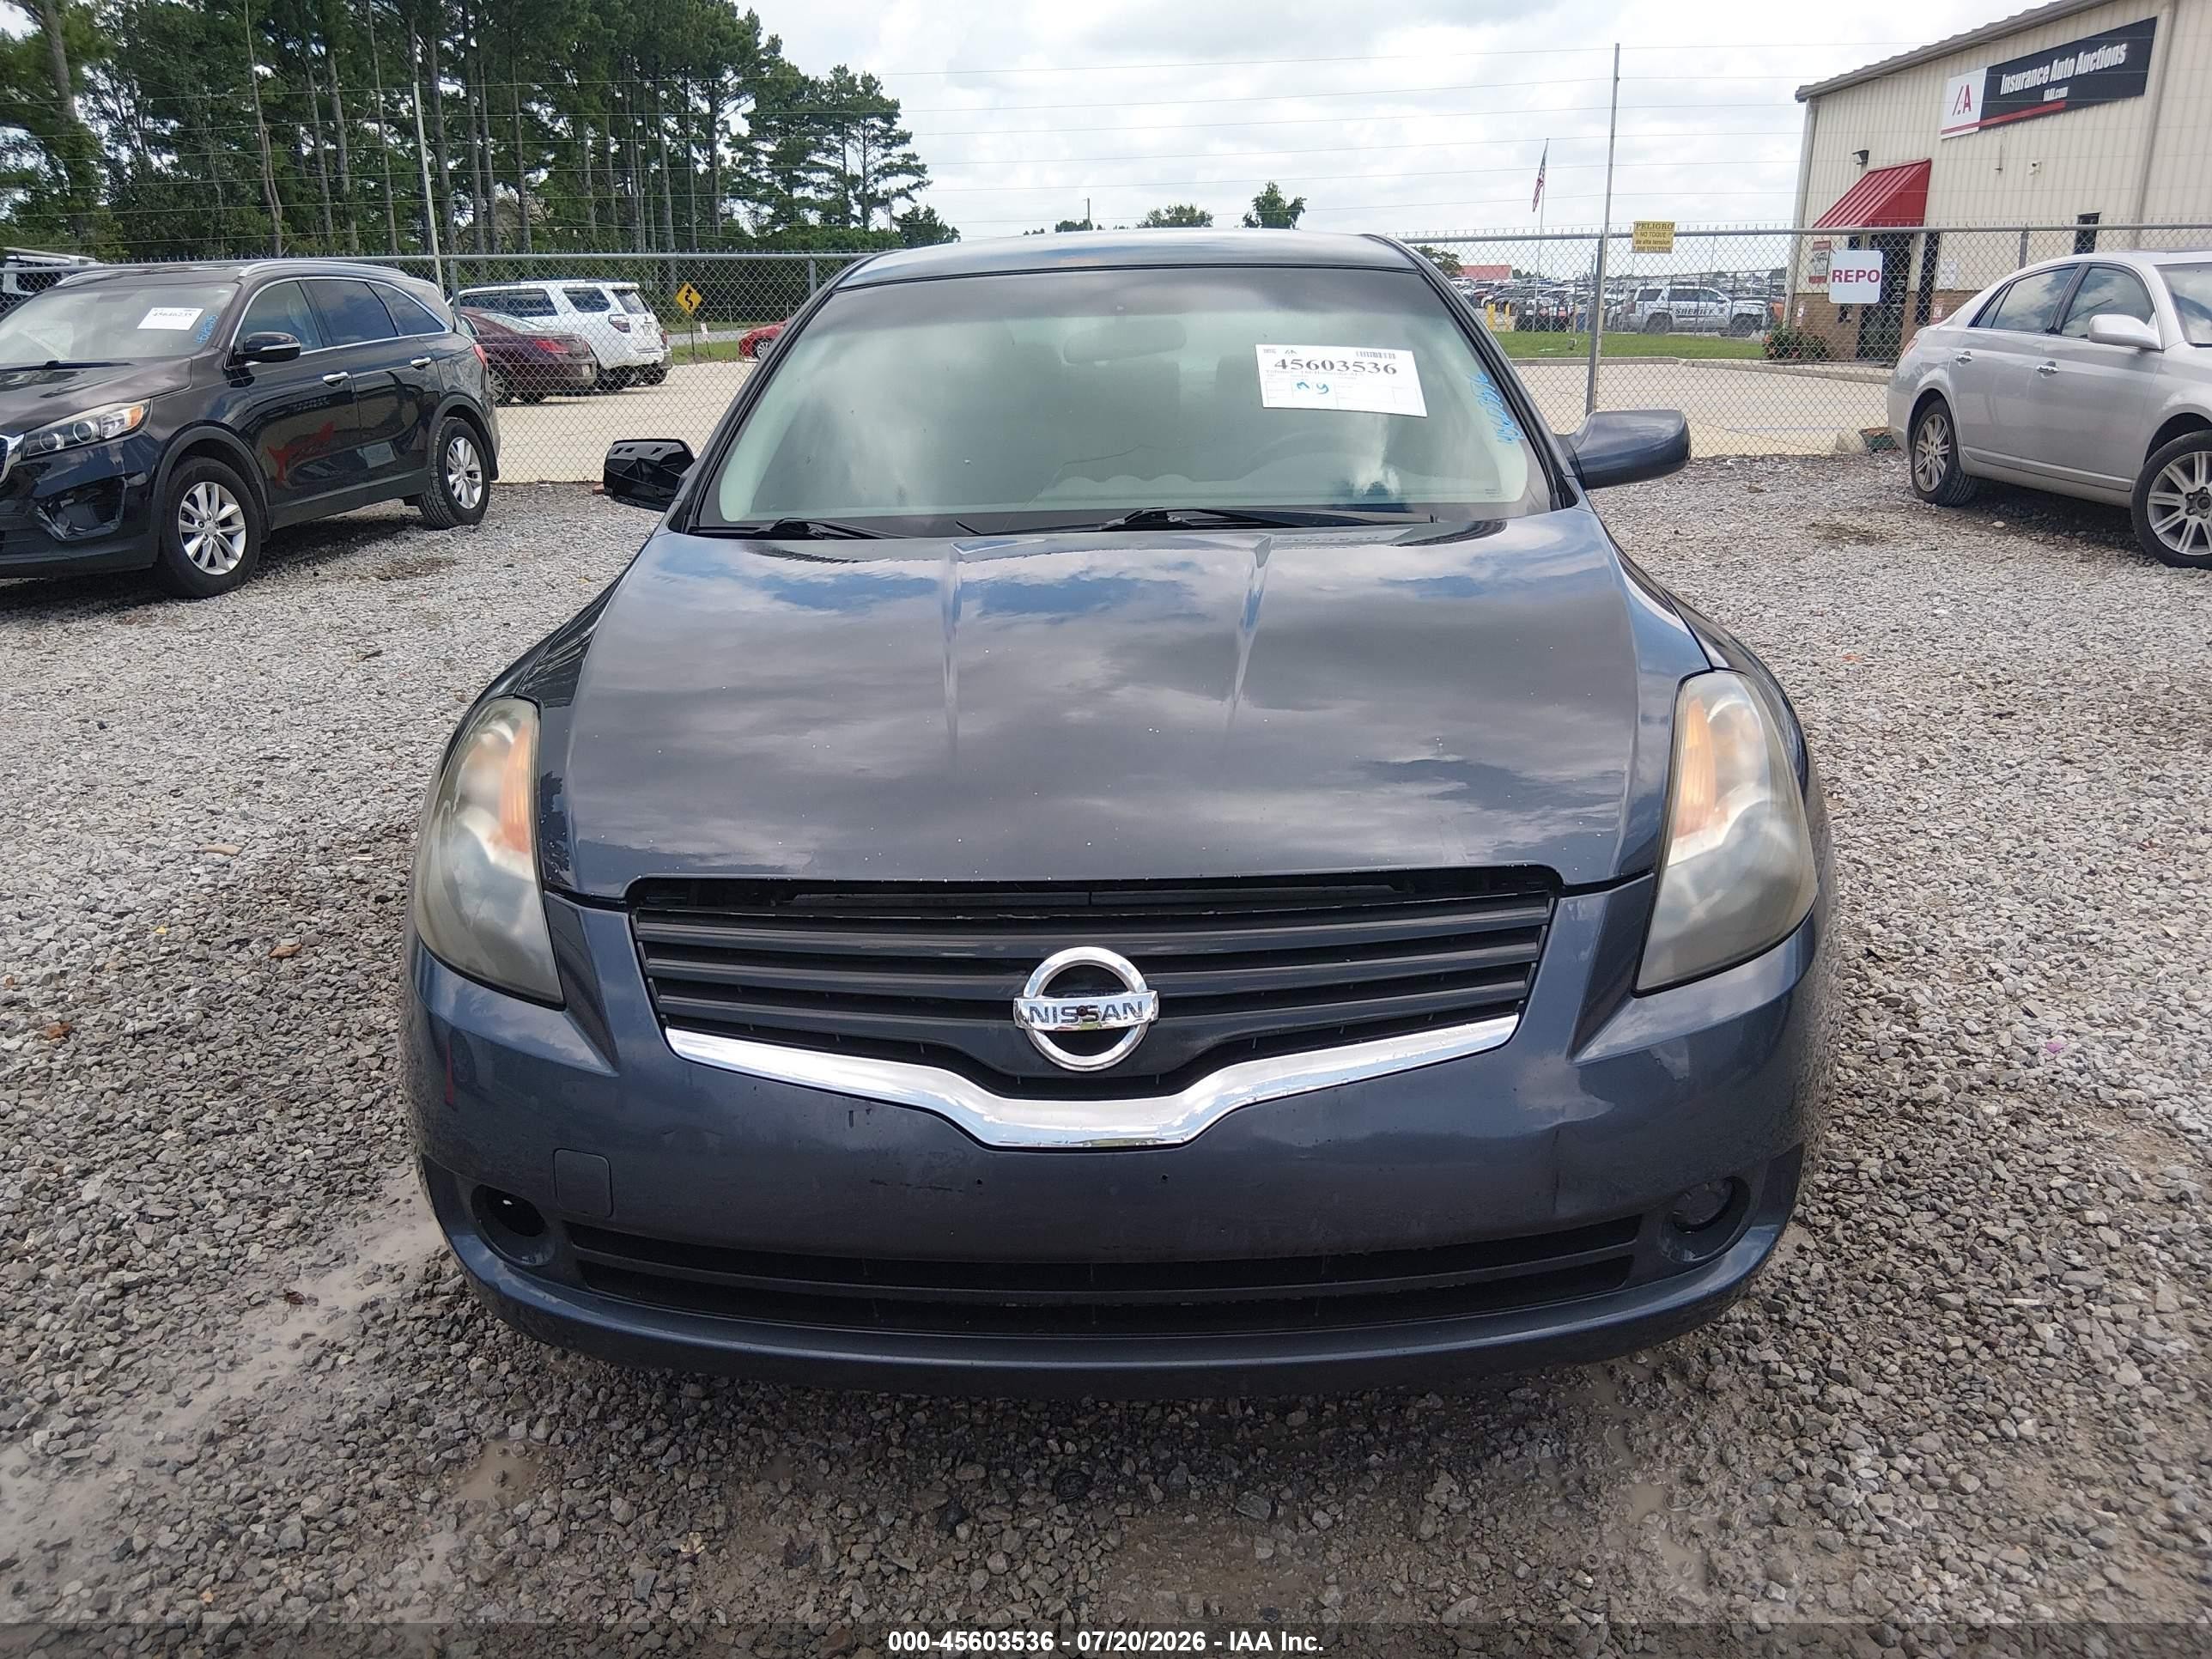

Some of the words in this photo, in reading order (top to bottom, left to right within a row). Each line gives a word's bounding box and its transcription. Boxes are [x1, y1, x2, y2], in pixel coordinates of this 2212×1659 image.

[2000, 65, 2050, 95] Insurance
[2050, 57, 2075, 82] Auto
[2075, 43, 2128, 76] Auctions
[1832, 269, 1881, 283] REPO
[1274, 358, 1398, 375] 45603536
[1030, 1000, 1144, 1024] NISSAN
